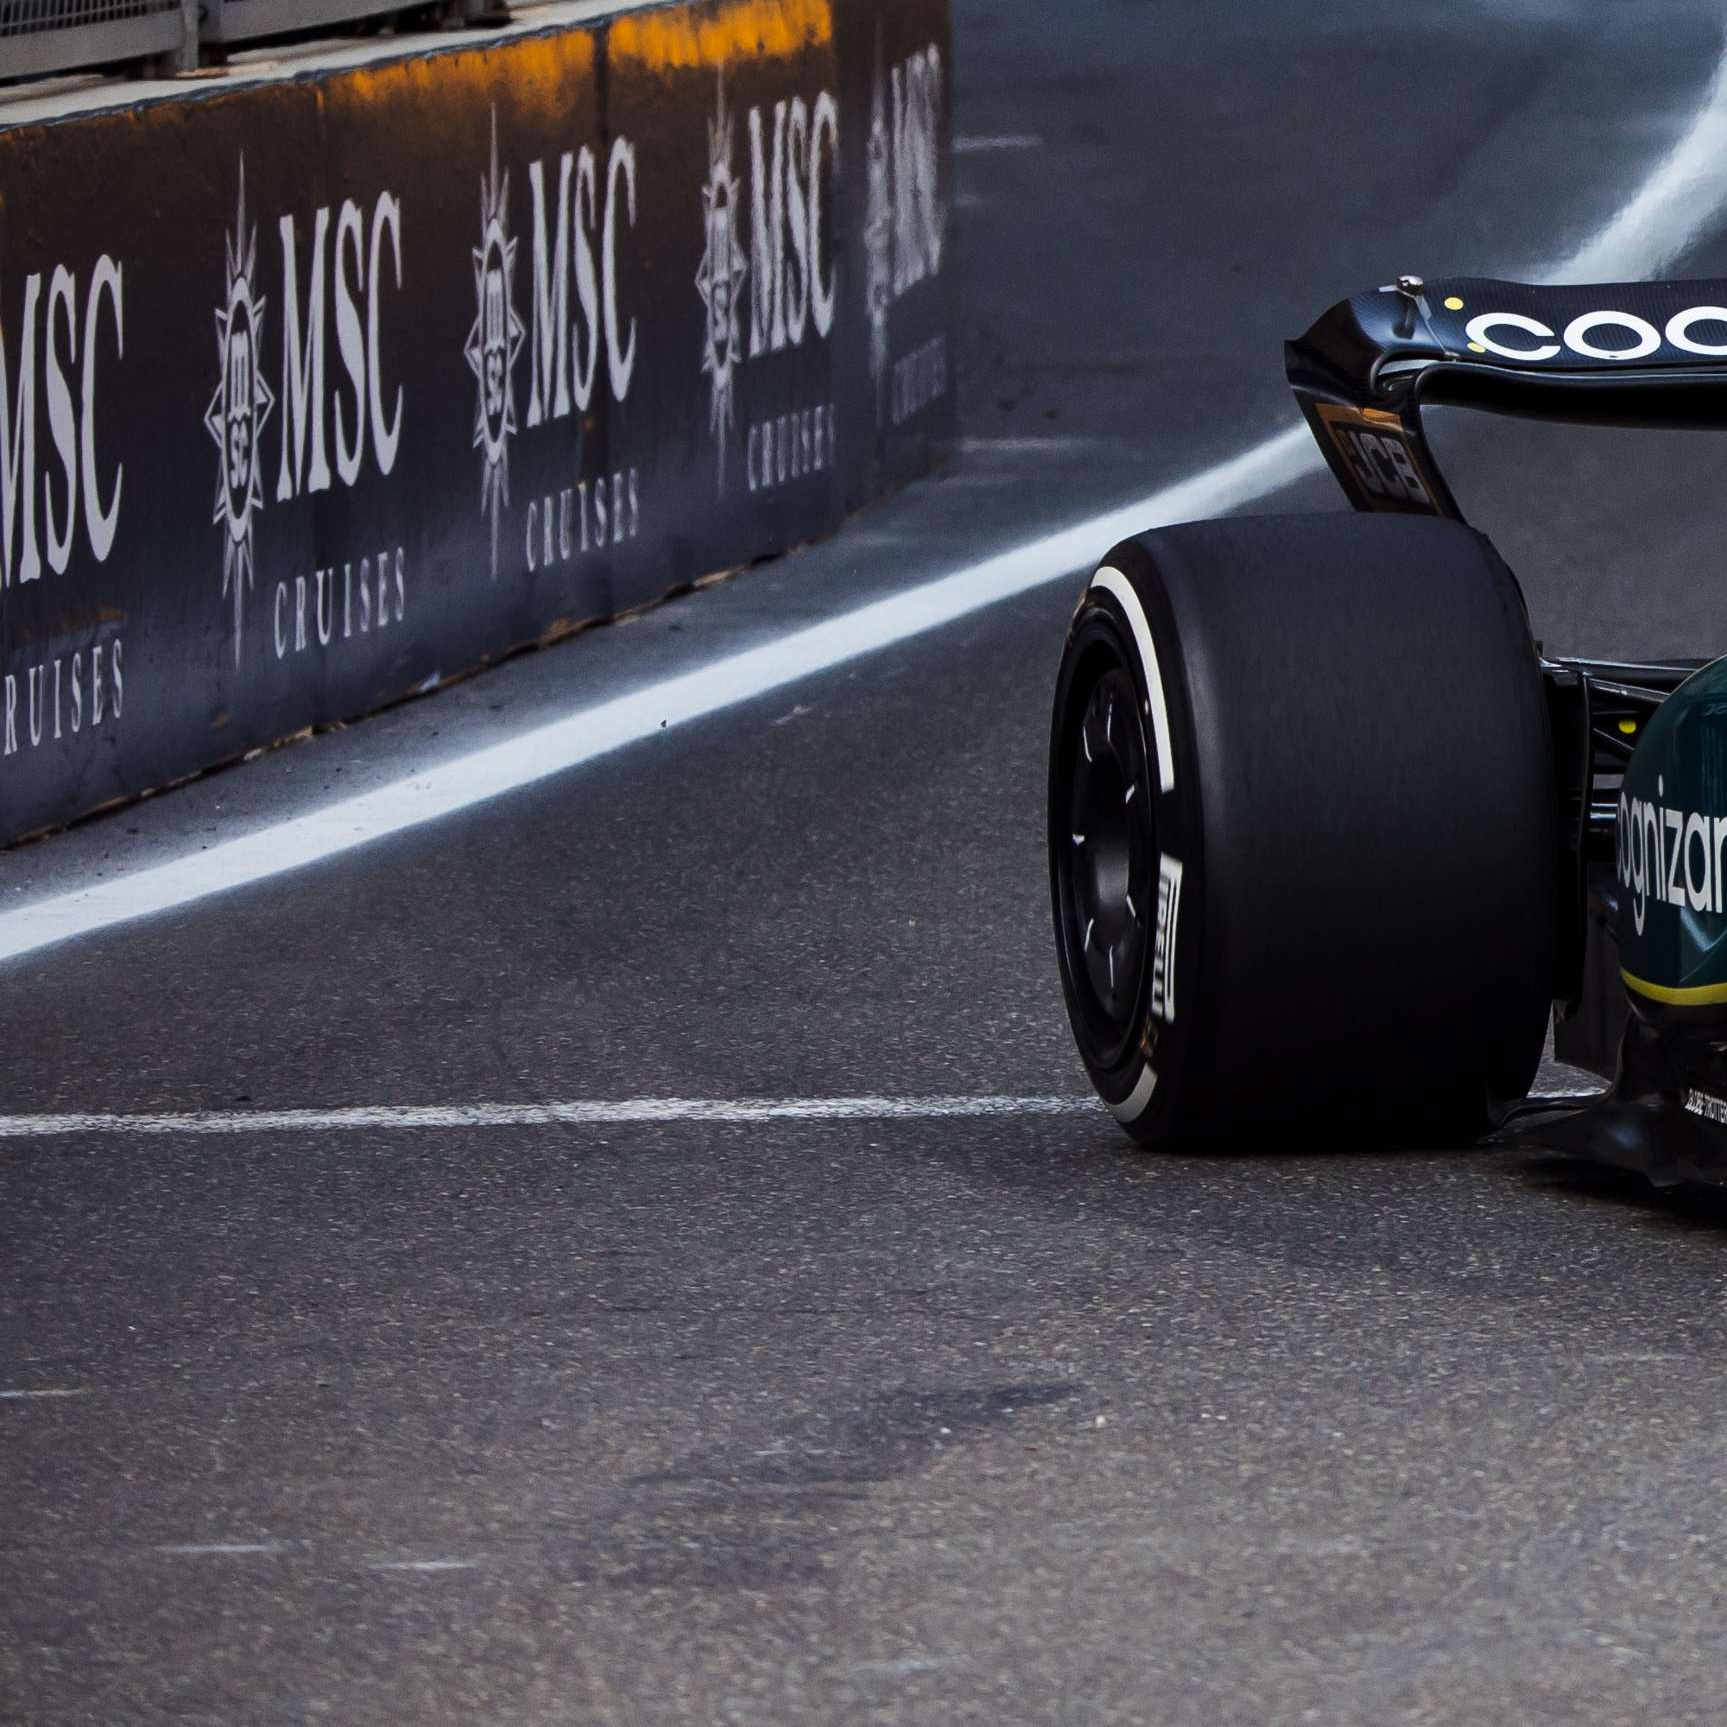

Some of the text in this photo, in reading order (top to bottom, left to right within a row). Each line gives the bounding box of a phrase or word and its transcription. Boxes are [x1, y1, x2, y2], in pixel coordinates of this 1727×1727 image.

[527, 134, 637, 428] MSC
[748, 89, 839, 359] MSC
[276, 189, 403, 503] MSC
[526, 467, 638, 573] CRUISES
[1348, 429, 1432, 505] JCB
[274, 546, 405, 660] CRUISES
